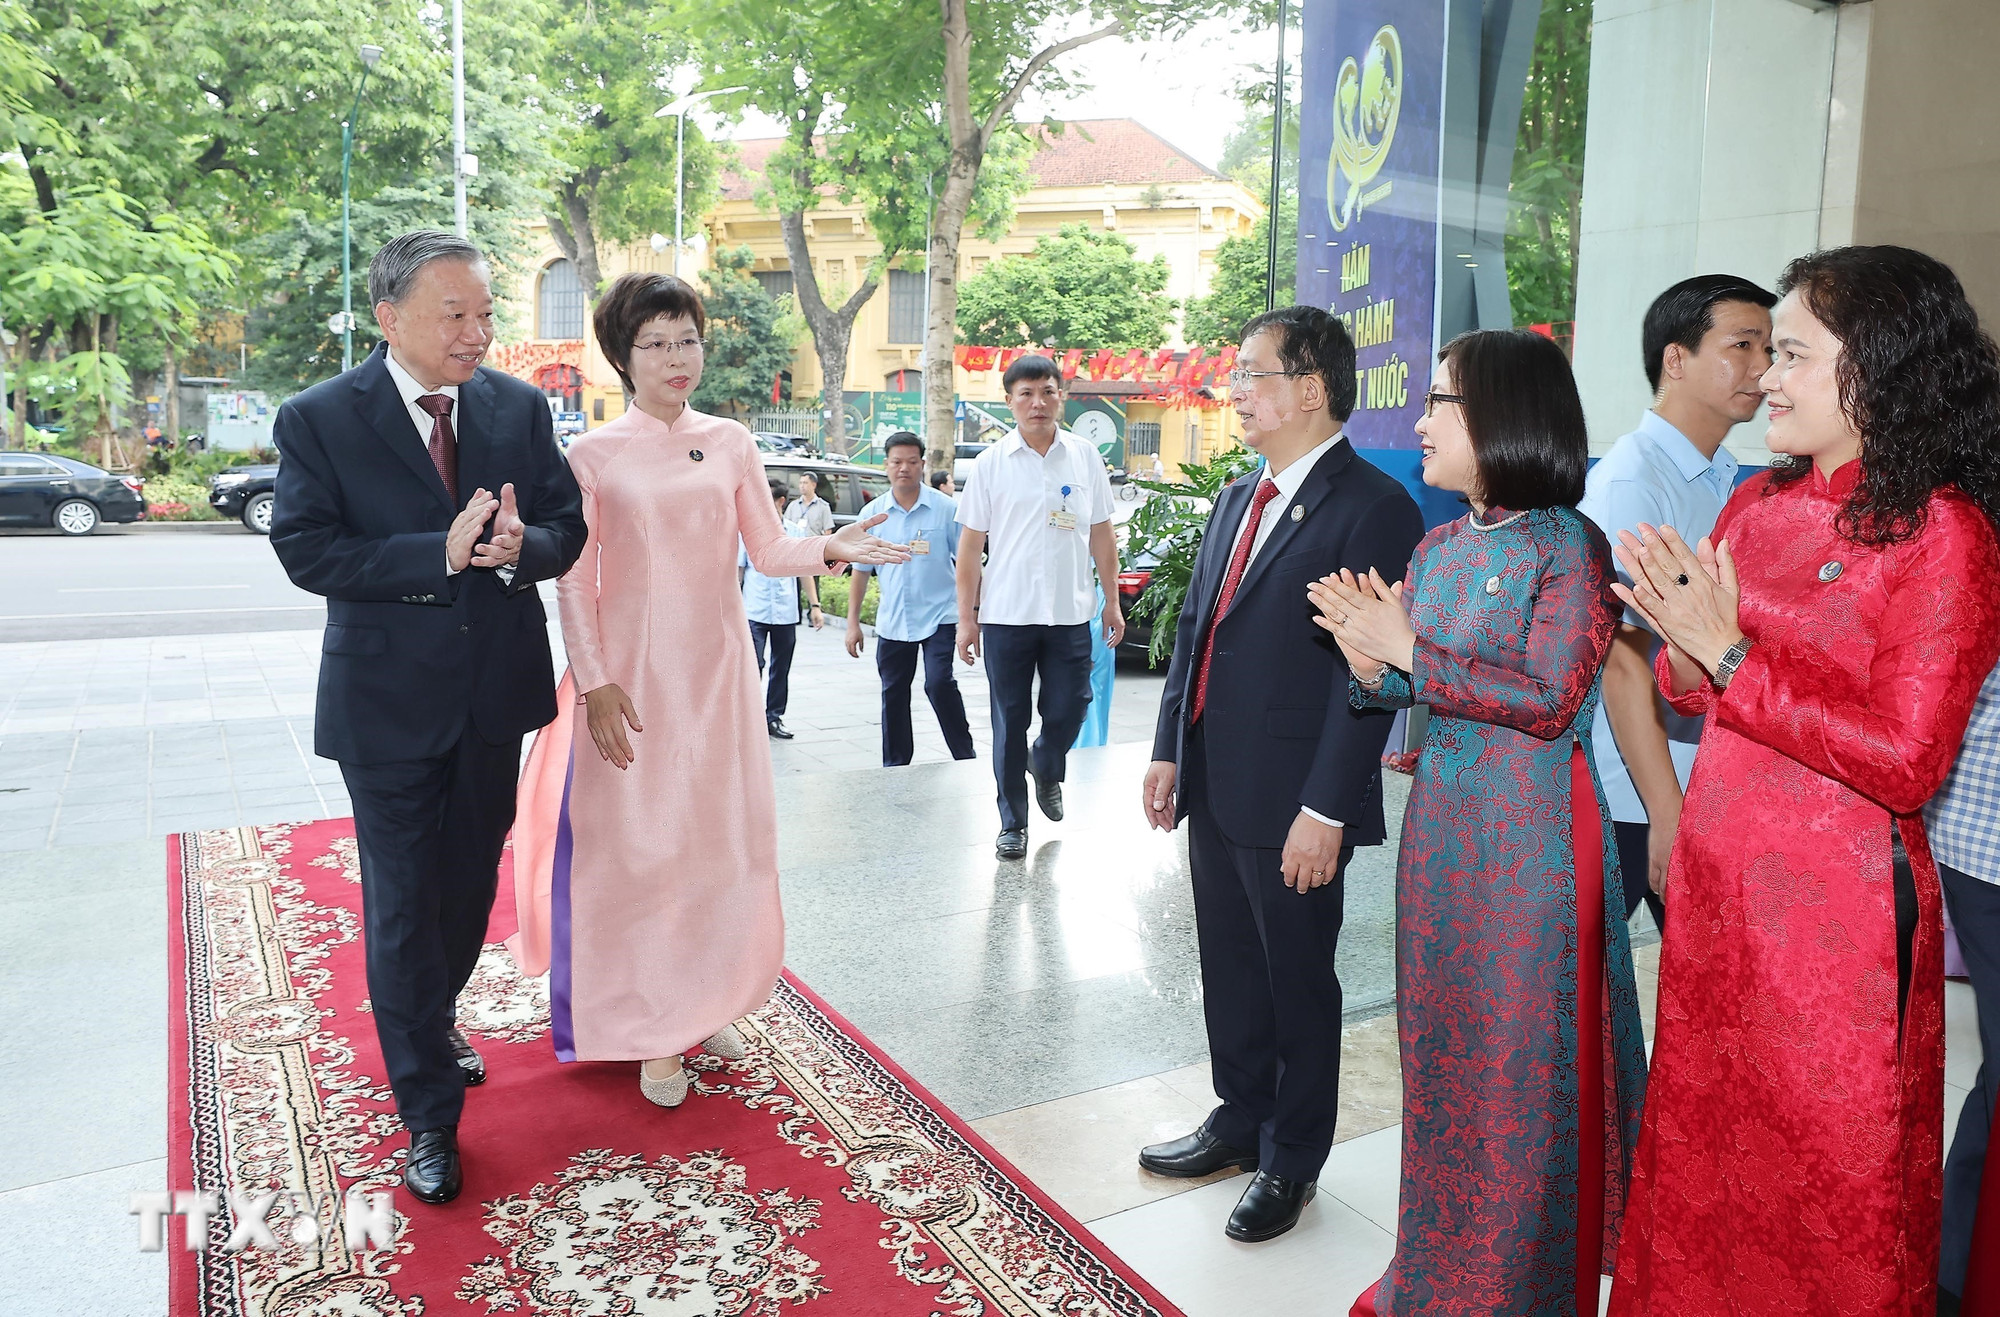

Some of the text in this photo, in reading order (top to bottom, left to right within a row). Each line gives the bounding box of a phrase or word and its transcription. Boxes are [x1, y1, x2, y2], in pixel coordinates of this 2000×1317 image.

[1341, 240, 1370, 293] NĂM
[1355, 295, 1395, 349] HÀNH
[1366, 352, 1409, 410] NƯỚC
